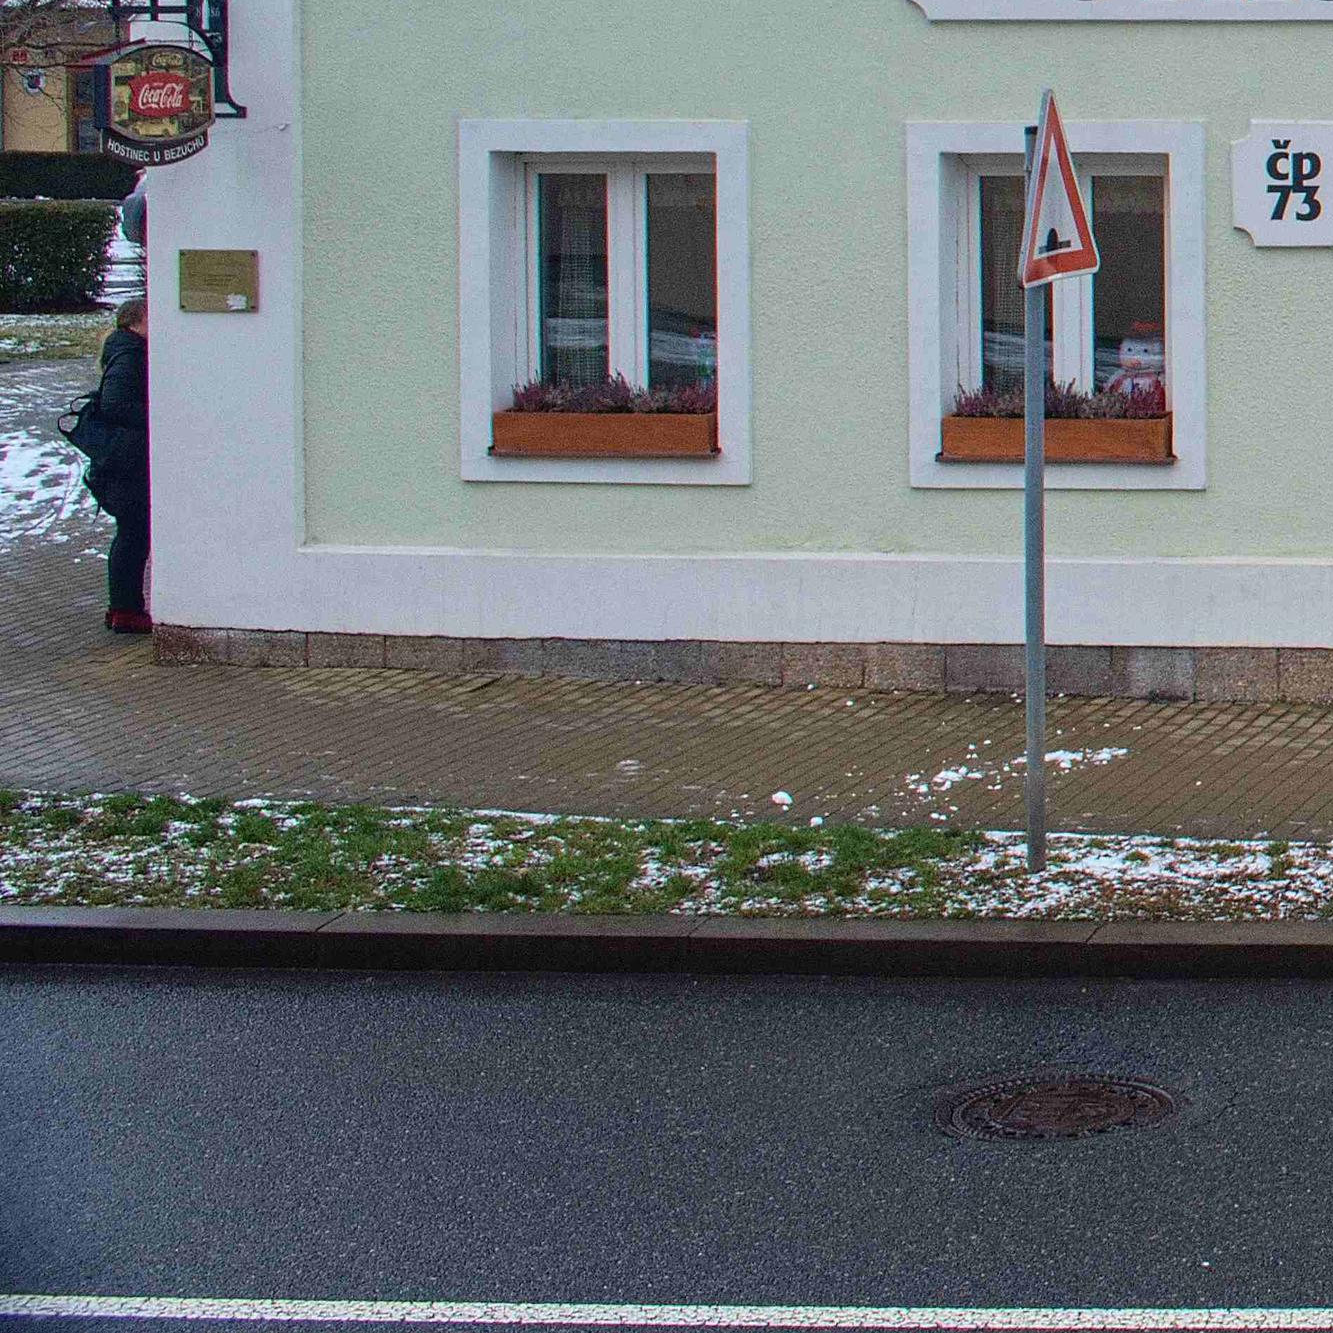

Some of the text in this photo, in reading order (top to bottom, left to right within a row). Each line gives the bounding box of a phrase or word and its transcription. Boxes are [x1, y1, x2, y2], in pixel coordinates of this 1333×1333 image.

[107, 137, 151, 162] HOSTINEC
[153, 150, 161, 162] U
[1265, 138, 1322, 189] čp
[1266, 184, 1322, 223] 73
